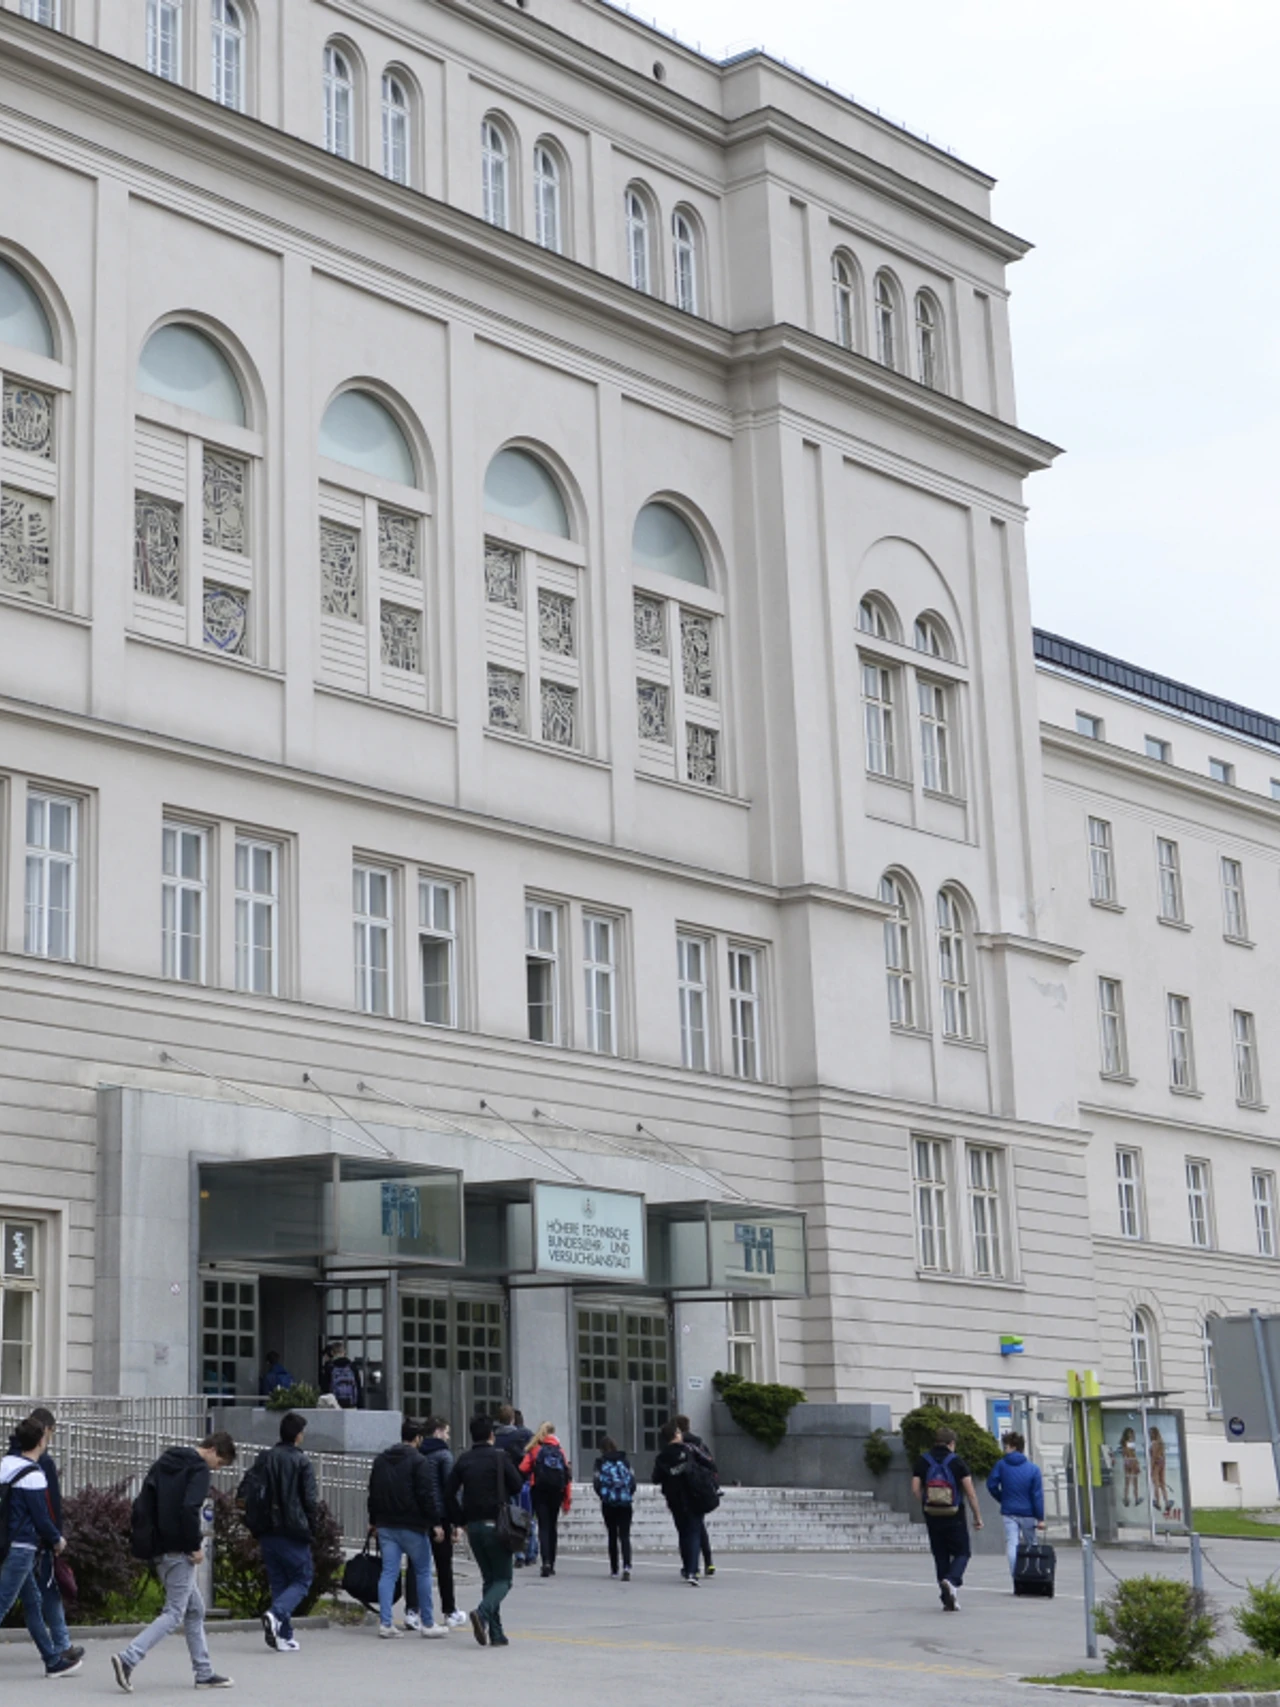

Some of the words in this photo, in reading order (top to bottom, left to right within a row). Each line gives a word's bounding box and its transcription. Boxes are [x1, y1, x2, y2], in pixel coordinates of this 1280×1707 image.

[547, 1218, 579, 1235] HÖHERE
[582, 1224, 630, 1240] TECHNISCHE
[610, 1241, 630, 1255] UND
[548, 1249, 630, 1268] VERSUCHSANSTALT
